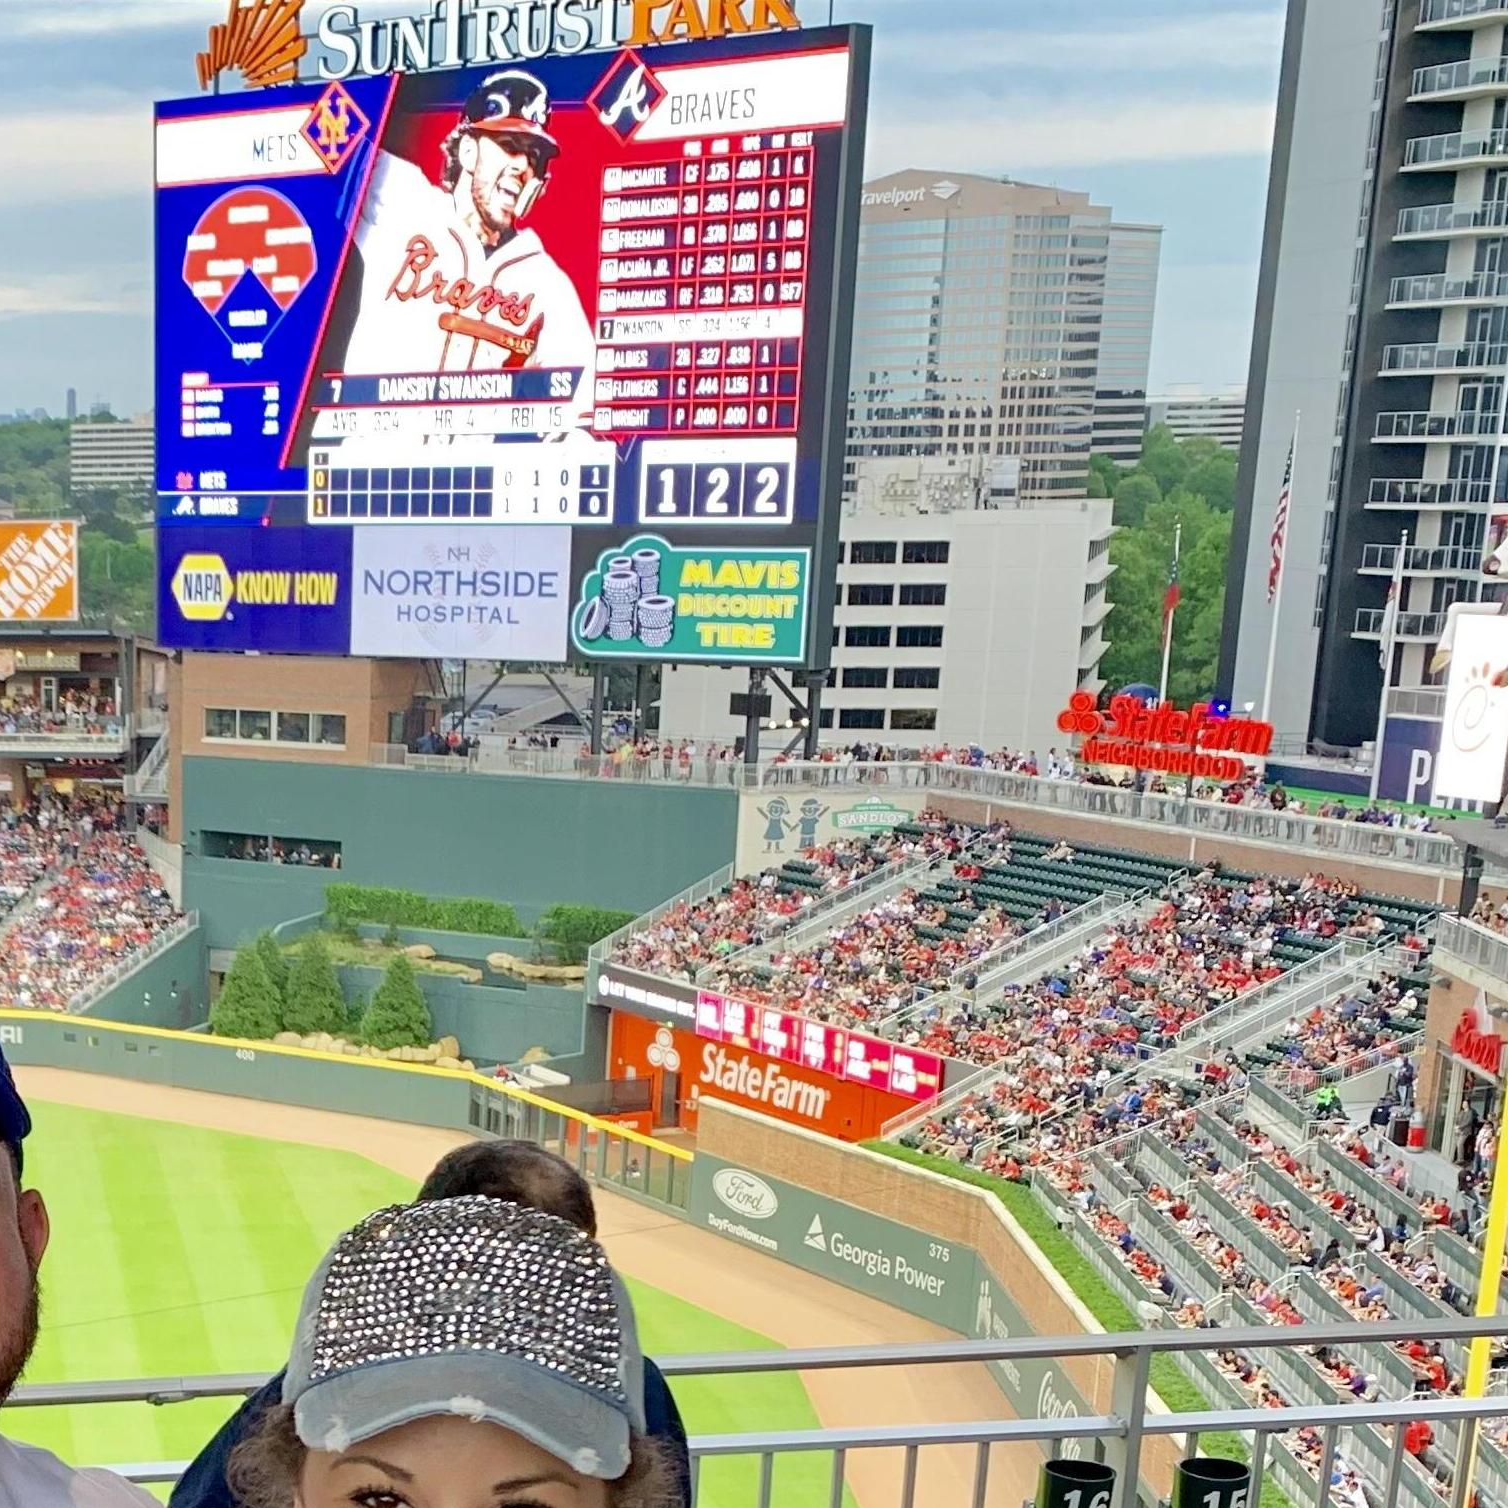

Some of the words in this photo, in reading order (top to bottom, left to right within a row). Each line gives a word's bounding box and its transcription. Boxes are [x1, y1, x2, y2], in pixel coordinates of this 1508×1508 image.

[670, 88, 756, 126] BRAVES
[252, 134, 298, 163] METS
[861, 187, 926, 208] ravelport
[619, 229, 664, 248] FREEMAN
[616, 289, 667, 307] MARKAKIS
[764, 282, 774, 300] 0
[331, 380, 342, 403] 7
[379, 376, 436, 401] DANSBY
[438, 374, 513, 400] SWANSON
[550, 372, 572, 397] SS
[612, 379, 659, 397] FLOWERS
[434, 409, 452, 429] HR
[511, 407, 534, 428] RBI
[549, 406, 562, 426] 15
[613, 409, 650, 427] WRIGHT
[676, 408, 684, 425] P
[758, 407, 767, 424] 0
[315, 470, 324, 488] 0
[532, 470, 540, 486] 1
[560, 470, 569, 487] 0
[592, 467, 600, 485] 1
[658, 469, 676, 513] 1
[706, 467, 729, 513] 2
[755, 467, 779, 513] 2
[316, 497, 324, 514] 1
[559, 496, 568, 513] 0
[589, 495, 600, 514] 0
[363, 569, 558, 598] NORTHSIDE
[679, 559, 800, 589] MAVIS
[182, 572, 224, 601] NAPA
[236, 571, 290, 604] KNOW
[294, 572, 337, 605] HOW
[396, 605, 520, 625] HOSPITAL
[677, 593, 799, 619] DISCOUNT
[696, 622, 776, 649] TIRE
[1081, 738, 1245, 781] NEIGHBORHOOD
[236, 1049, 255, 1062] 400
[726, 1175, 764, 1212] Ford
[830, 1232, 891, 1277] Georgia
[894, 1256, 946, 1297] Power
[929, 1242, 950, 1263] 375
